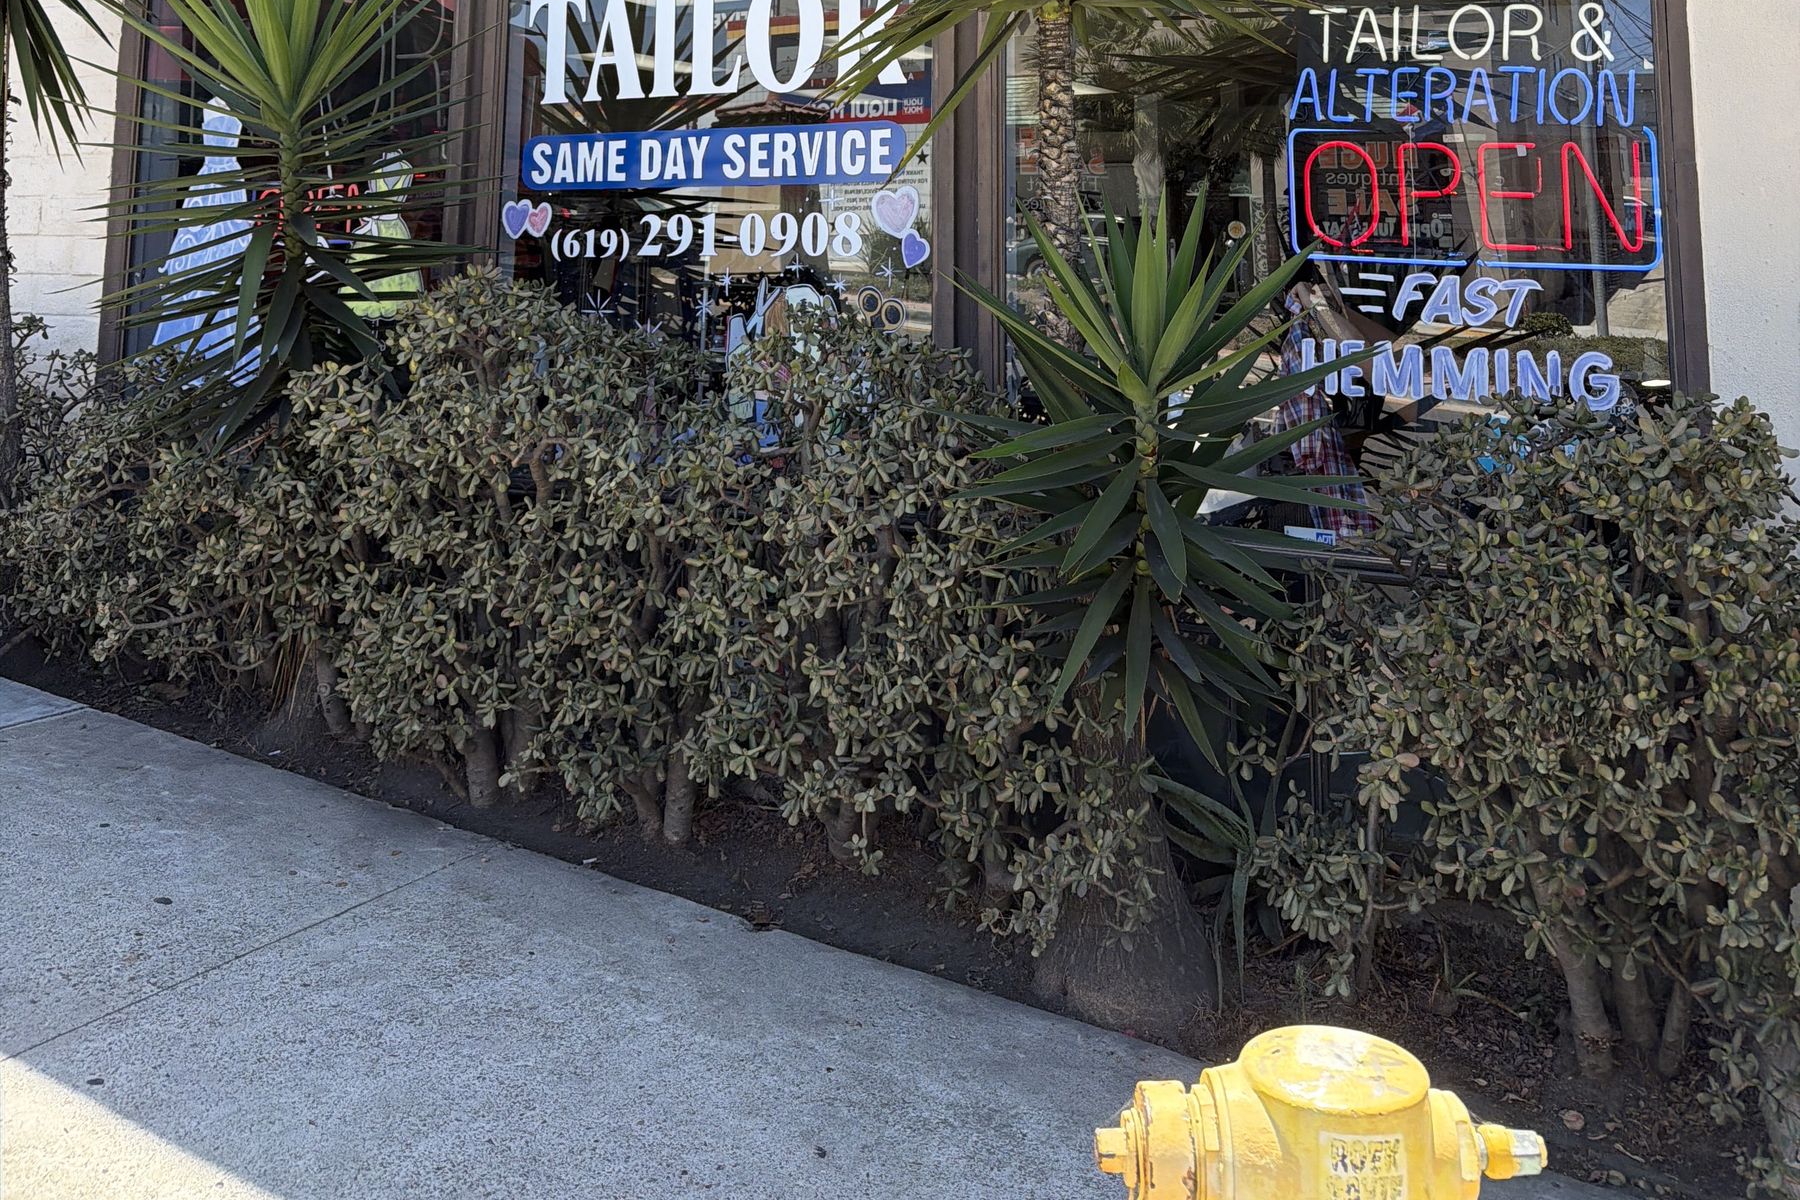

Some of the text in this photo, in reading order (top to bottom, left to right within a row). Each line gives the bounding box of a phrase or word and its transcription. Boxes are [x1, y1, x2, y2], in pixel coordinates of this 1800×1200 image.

[1309, 2, 1615, 64] TAILOR &
[1289, 66, 1636, 127] ALTERATION
[530, 127, 894, 185] SAME DAY SERVICE
[1304, 141, 1643, 253] OPEN
[550, 211, 863, 263] (619) 291-0908
[1392, 272, 1545, 328] FAST
[1300, 337, 1620, 411] HEMMING
